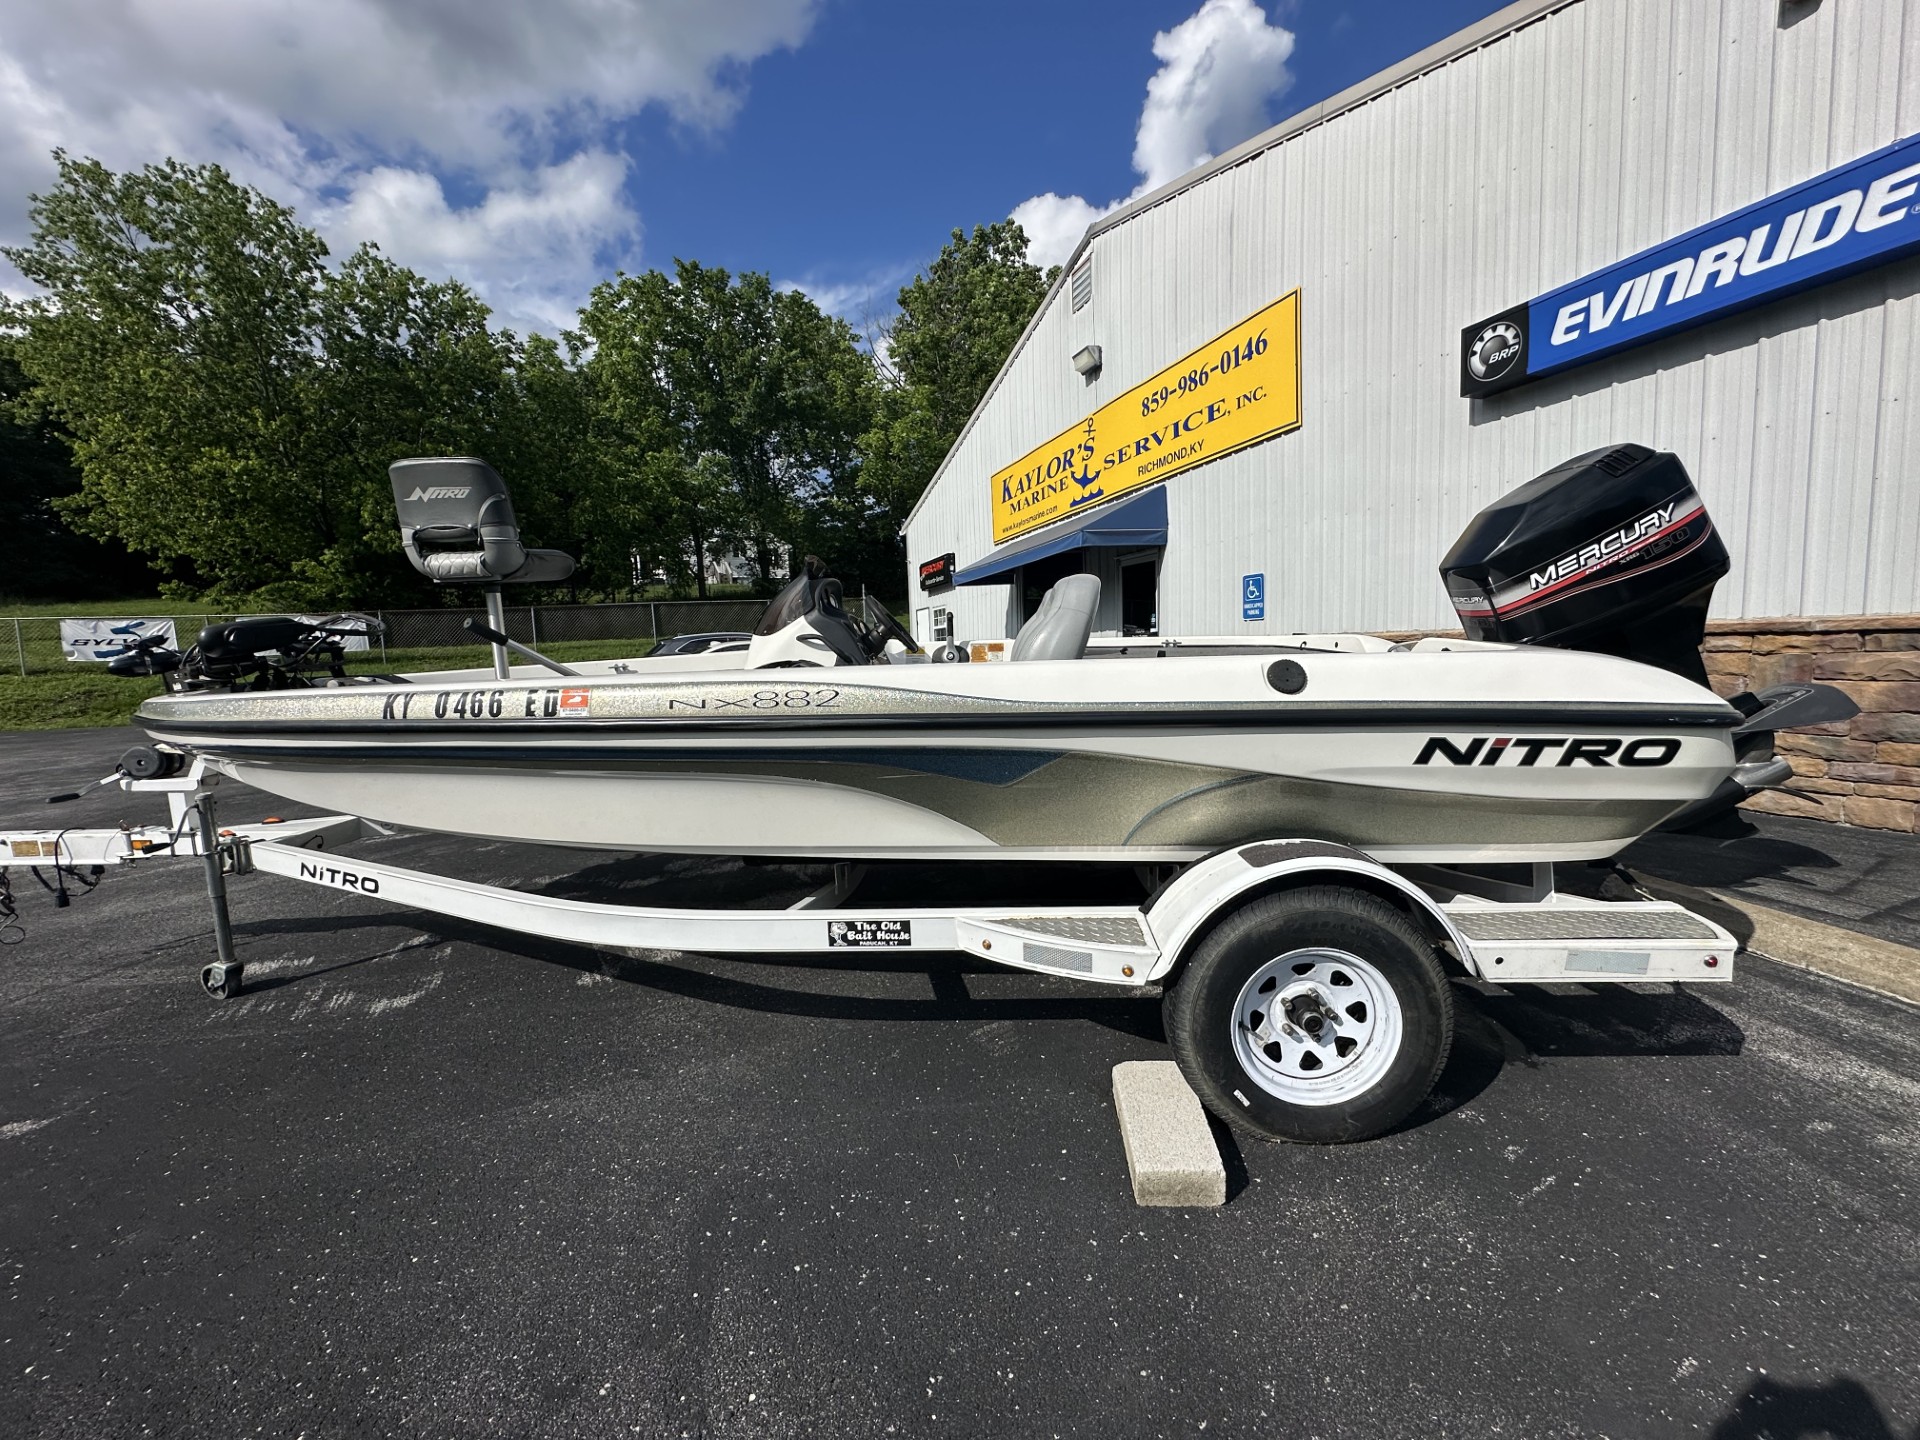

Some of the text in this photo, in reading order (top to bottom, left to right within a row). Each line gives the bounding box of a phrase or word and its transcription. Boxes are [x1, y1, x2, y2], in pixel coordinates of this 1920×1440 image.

[1550, 163, 1920, 346] EVINRUDE
[1141, 328, 1268, 417] 859-986-0146
[1488, 344, 1519, 364] BRP
[1103, 386, 1267, 471] SERVICE, INC.
[1001, 437, 1096, 504] KAYLOR'S
[1138, 439, 1205, 476] RICHMOND,KY
[403, 486, 472, 502] NITRO
[1009, 476, 1069, 515] MARINE
[1529, 502, 1675, 589] MERCURY
[383, 692, 417, 719] KY
[435, 689, 504, 718] 0466
[669, 689, 841, 710] NX882
[847, 931, 910, 940] Bait House
[855, 922, 901, 930] The Old
